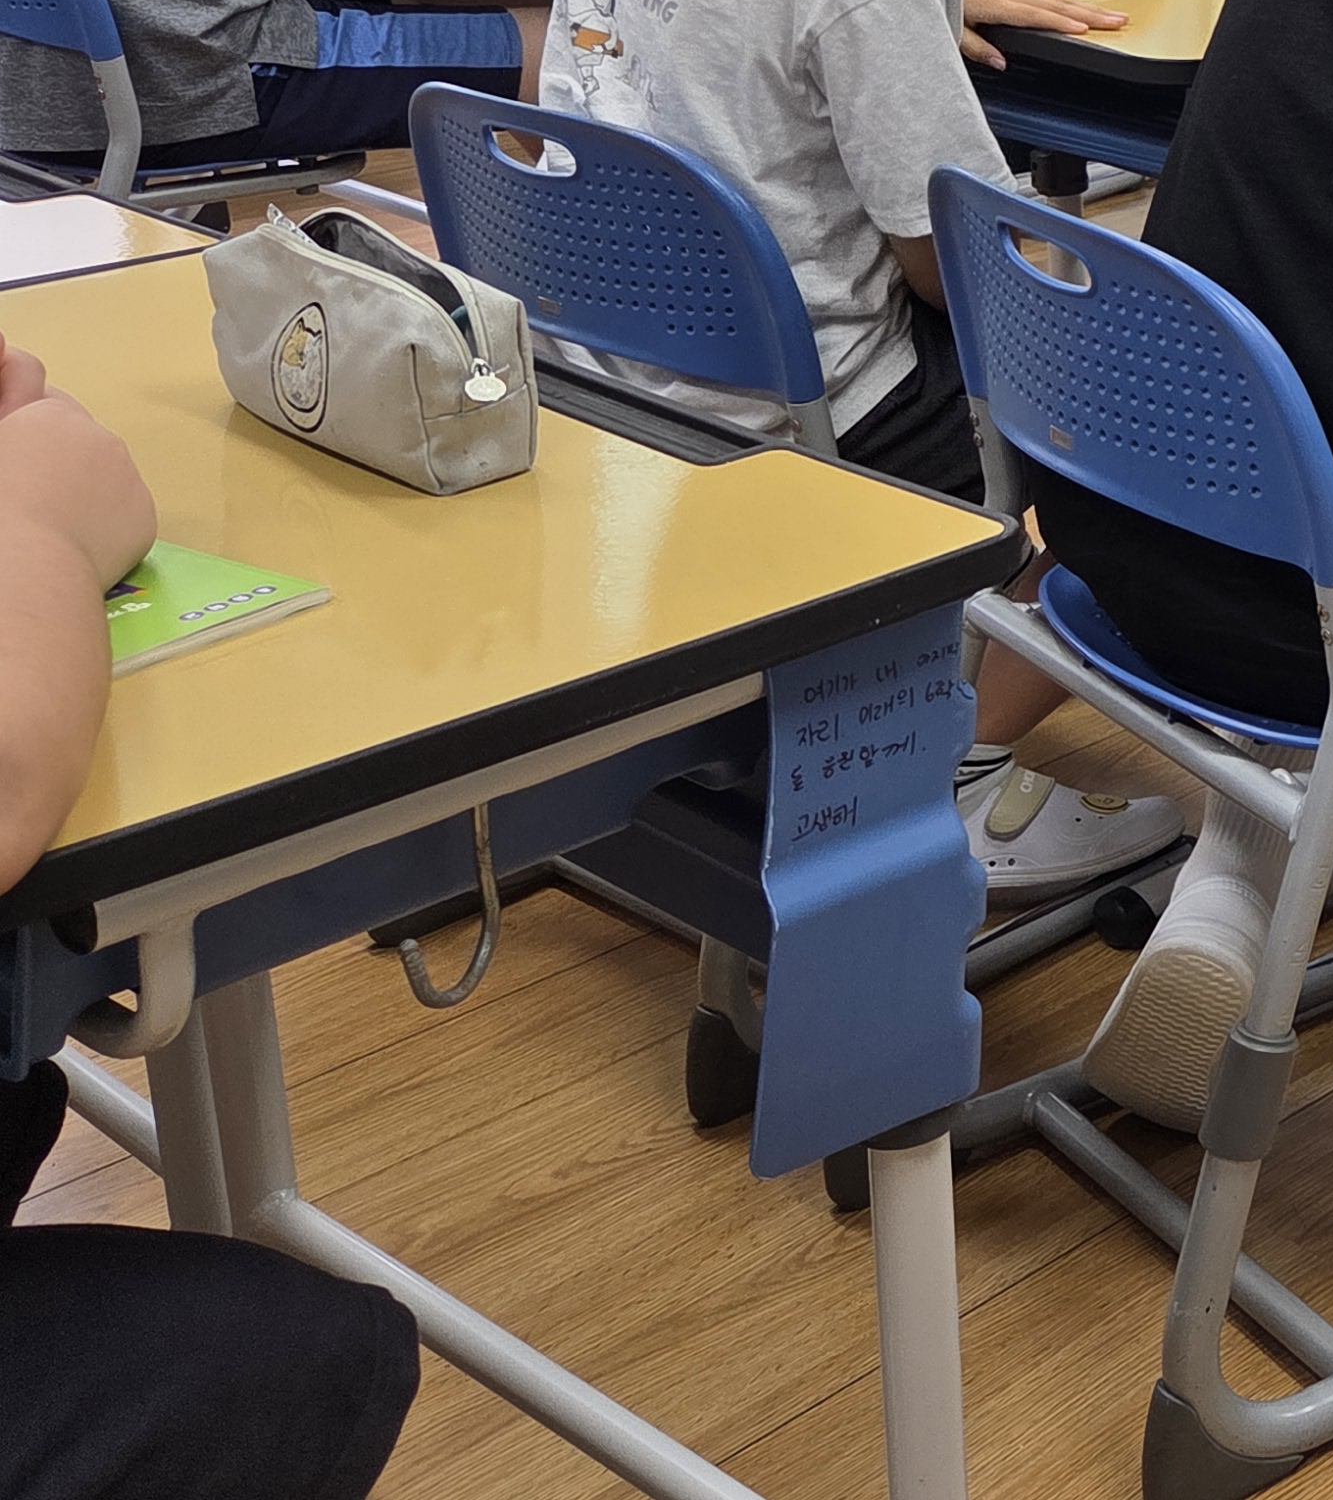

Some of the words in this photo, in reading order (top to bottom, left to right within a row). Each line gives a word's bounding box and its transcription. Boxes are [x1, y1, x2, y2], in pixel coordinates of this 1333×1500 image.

[803, 673, 857, 704] 여기가
[875, 659, 898, 683] 내
[796, 713, 840, 747] 자리
[791, 795, 858, 842] 고생해
